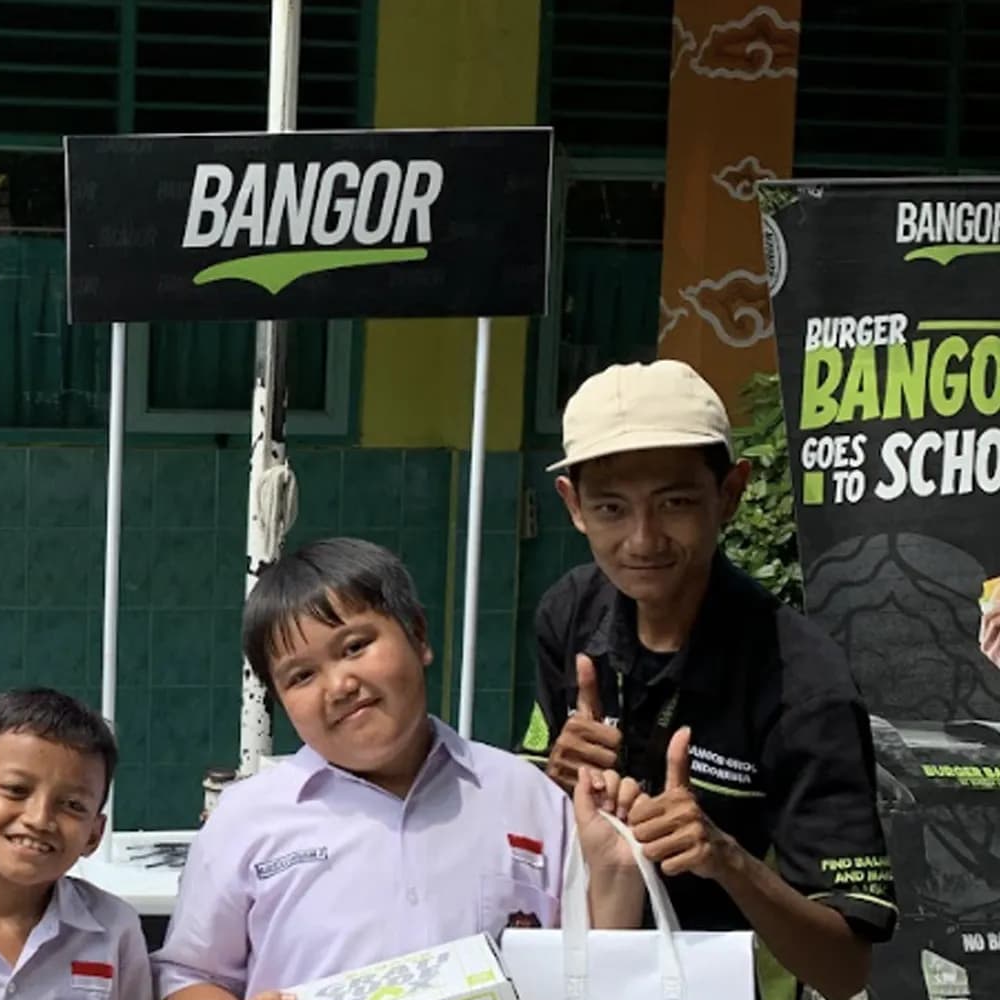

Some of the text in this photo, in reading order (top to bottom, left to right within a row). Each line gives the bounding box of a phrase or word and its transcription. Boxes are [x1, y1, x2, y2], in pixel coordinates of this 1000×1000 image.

[182, 159, 444, 249] BANGOR
[804, 312, 909, 352] BURGER
[801, 433, 868, 470] GOES
[831, 469, 867, 504] TO
[961, 933, 985, 954] NO
